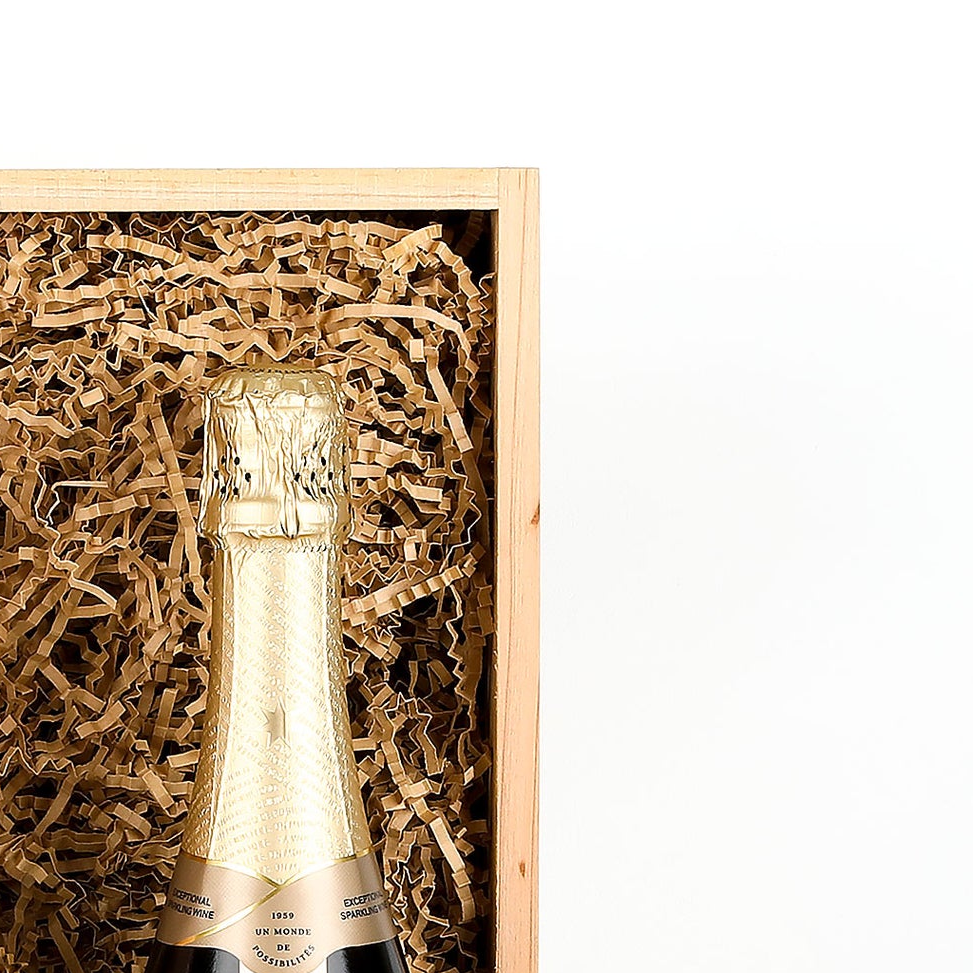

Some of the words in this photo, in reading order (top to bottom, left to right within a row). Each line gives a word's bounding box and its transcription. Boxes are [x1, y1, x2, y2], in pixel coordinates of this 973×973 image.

[192, 907, 215, 920] WINE
[271, 912, 295, 920] 1959
[255, 928, 270, 936] UN
[273, 928, 312, 936] MONDE
[276, 944, 291, 952] DE
